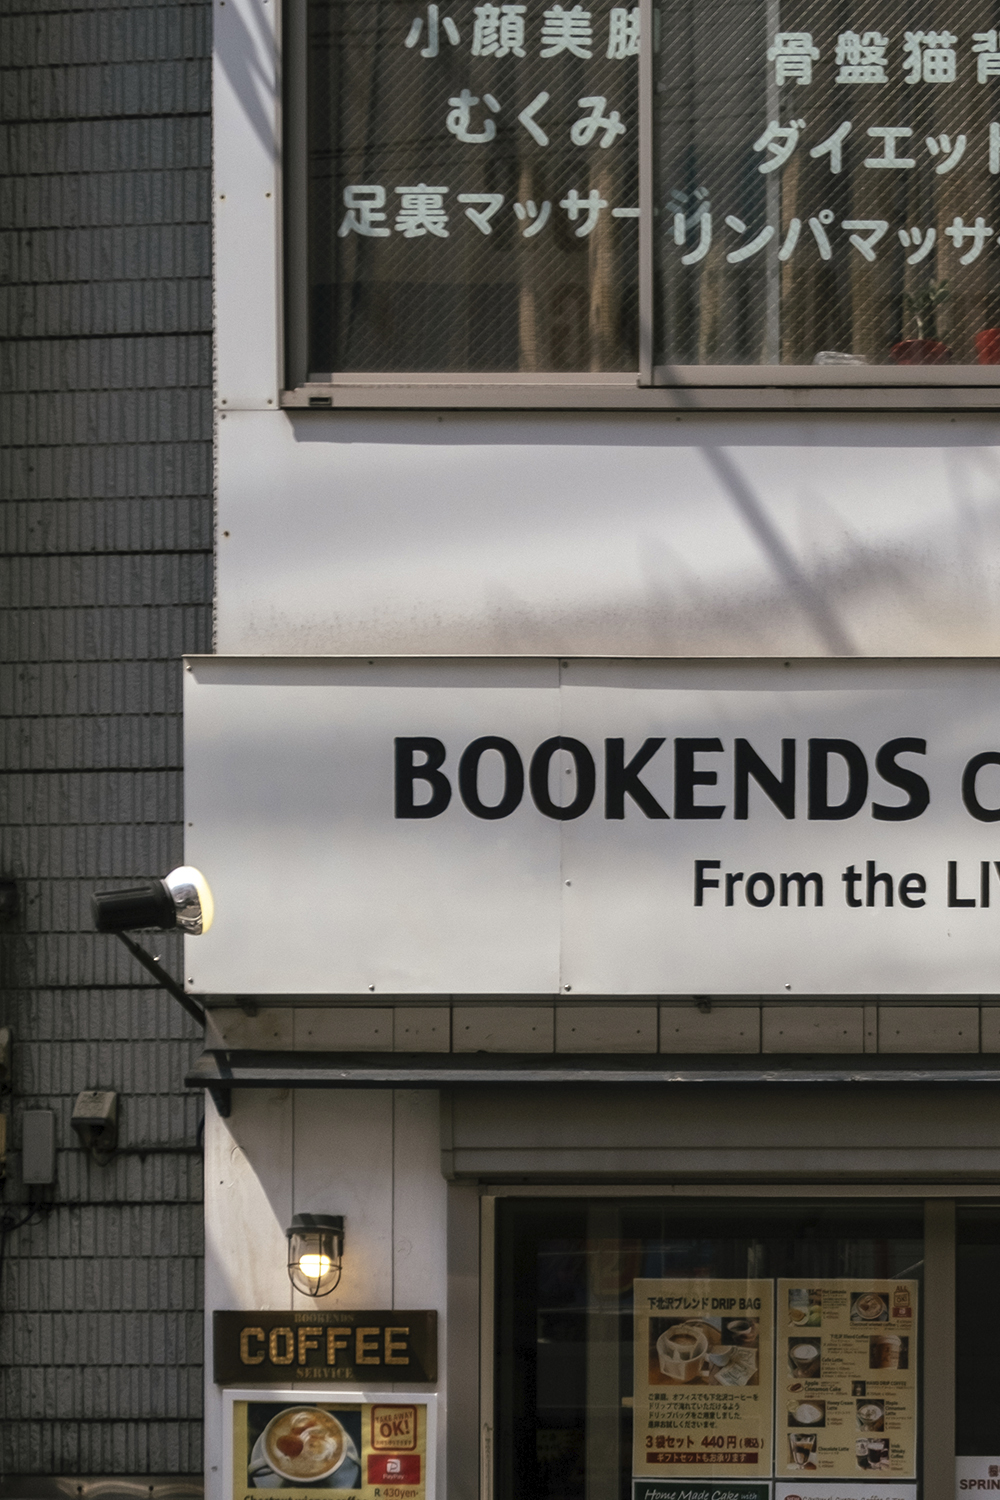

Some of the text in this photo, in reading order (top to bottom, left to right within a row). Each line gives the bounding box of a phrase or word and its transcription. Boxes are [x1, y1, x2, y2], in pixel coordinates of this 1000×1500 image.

[446, 88, 627, 148] むくみ
[393, 735, 930, 821] BOOKENDS
[693, 859, 824, 908] From
[841, 861, 927, 908] the
[711, 1298, 736, 1310] DRIP
[739, 1298, 761, 1310] BAG
[294, 1313, 354, 1323] BOOKENDS
[240, 1326, 409, 1365] COFFEE
[296, 1368, 353, 1379] SERVICE
[375, 1411, 413, 1423] TAKE AWAY
[380, 1419, 410, 1438] OK!
[374, 1488, 381, 1497] R
